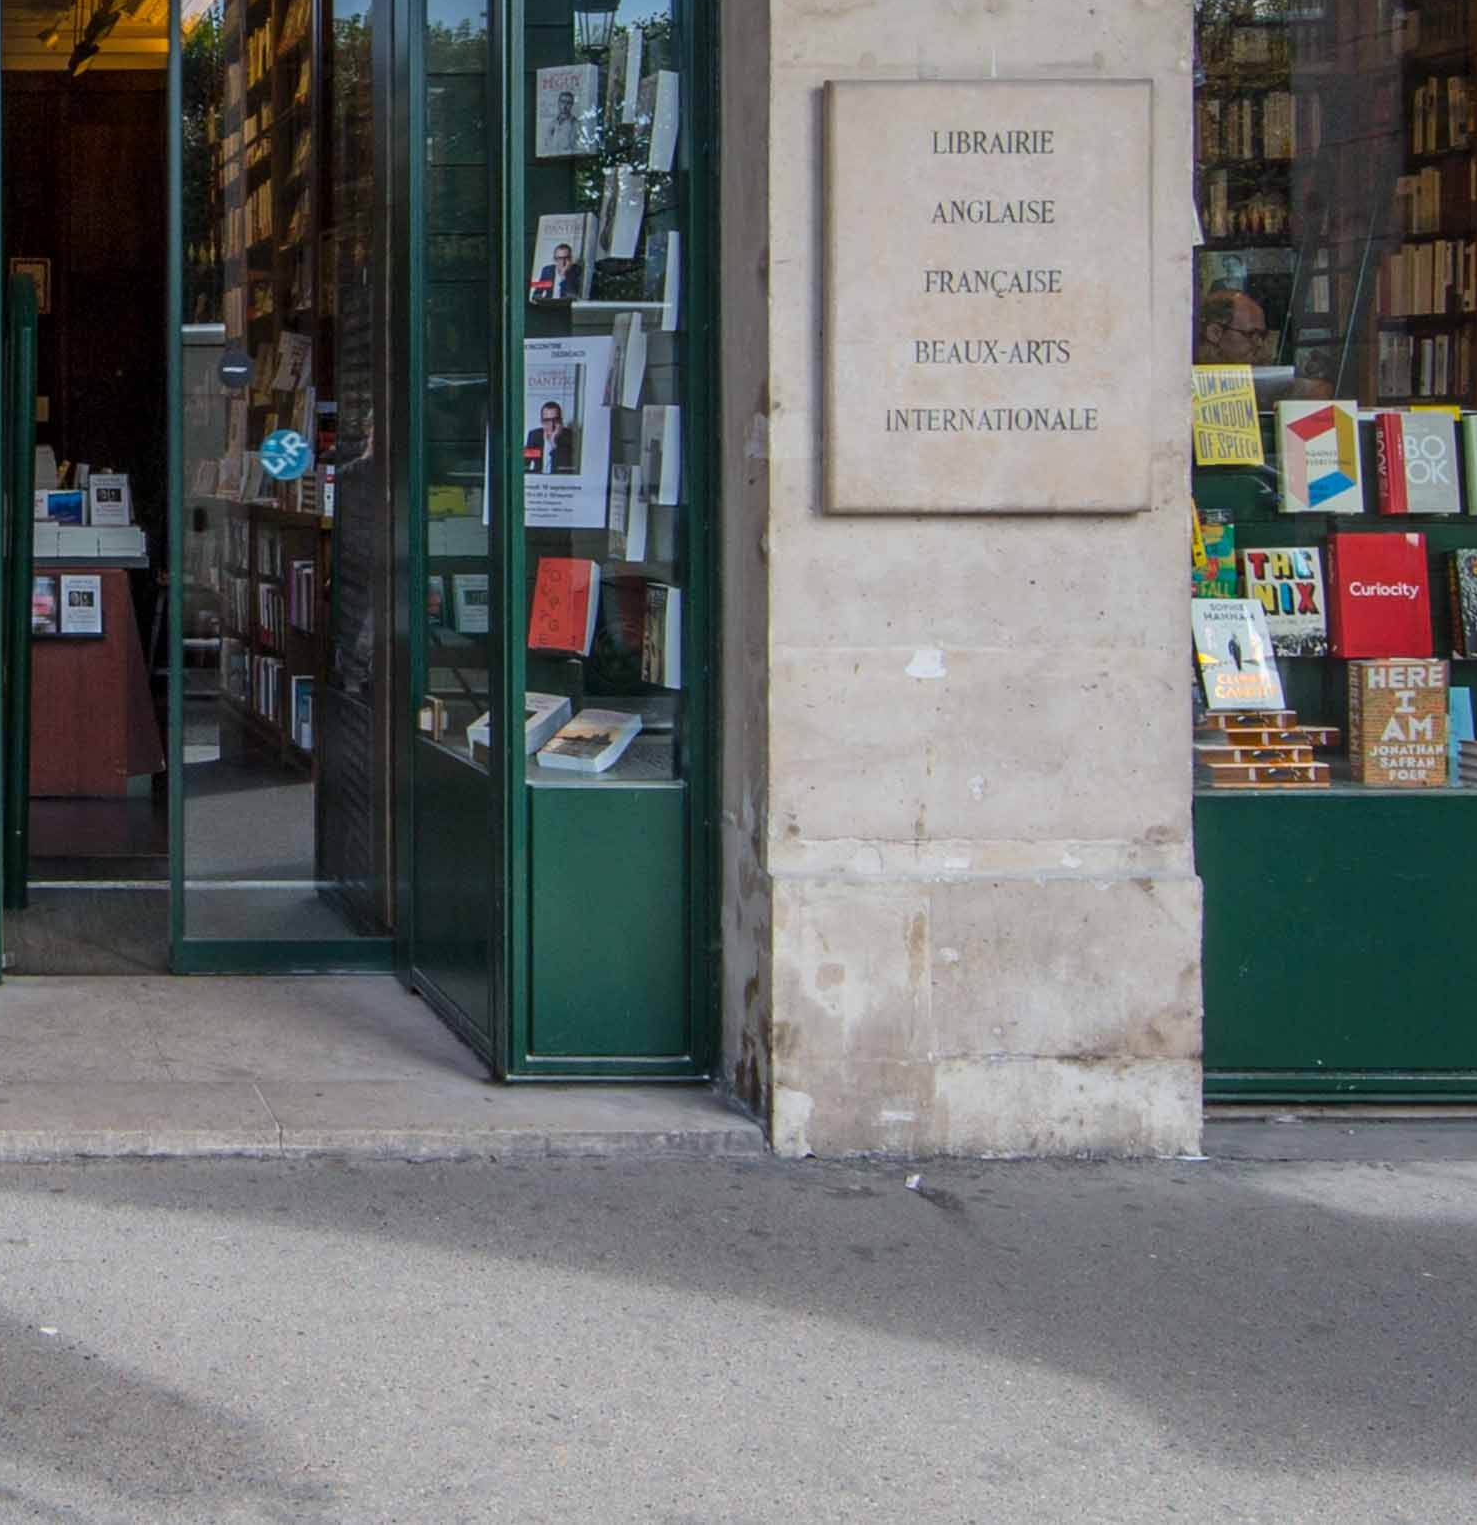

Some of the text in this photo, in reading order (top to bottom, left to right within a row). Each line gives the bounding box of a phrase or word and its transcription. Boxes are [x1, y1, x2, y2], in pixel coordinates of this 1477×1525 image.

[932, 130, 1055, 155] LIBRAIRIE
[931, 200, 1056, 224] ANGLAISE
[925, 270, 1063, 298] FRANÇAISE
[915, 340, 1071, 365] BEAUX-ARTS
[885, 408, 1099, 432] INTERNATIONALE
[1200, 397, 1255, 428] KINGDOM
[1198, 430, 1260, 459] OF SPEECH
[1405, 435, 1446, 459] BO
[1407, 459, 1451, 484] OK
[1248, 551, 1315, 580] THE
[1252, 582, 1320, 616] NIX
[1349, 581, 1420, 600] Curiocity
[1367, 665, 1444, 690] HERE
[1394, 690, 1416, 714] I
[1381, 714, 1434, 742] AM
[1368, 744, 1446, 757] JONATHAN
[1380, 757, 1435, 768] SAFRAN
[1388, 769, 1427, 781] FOER
